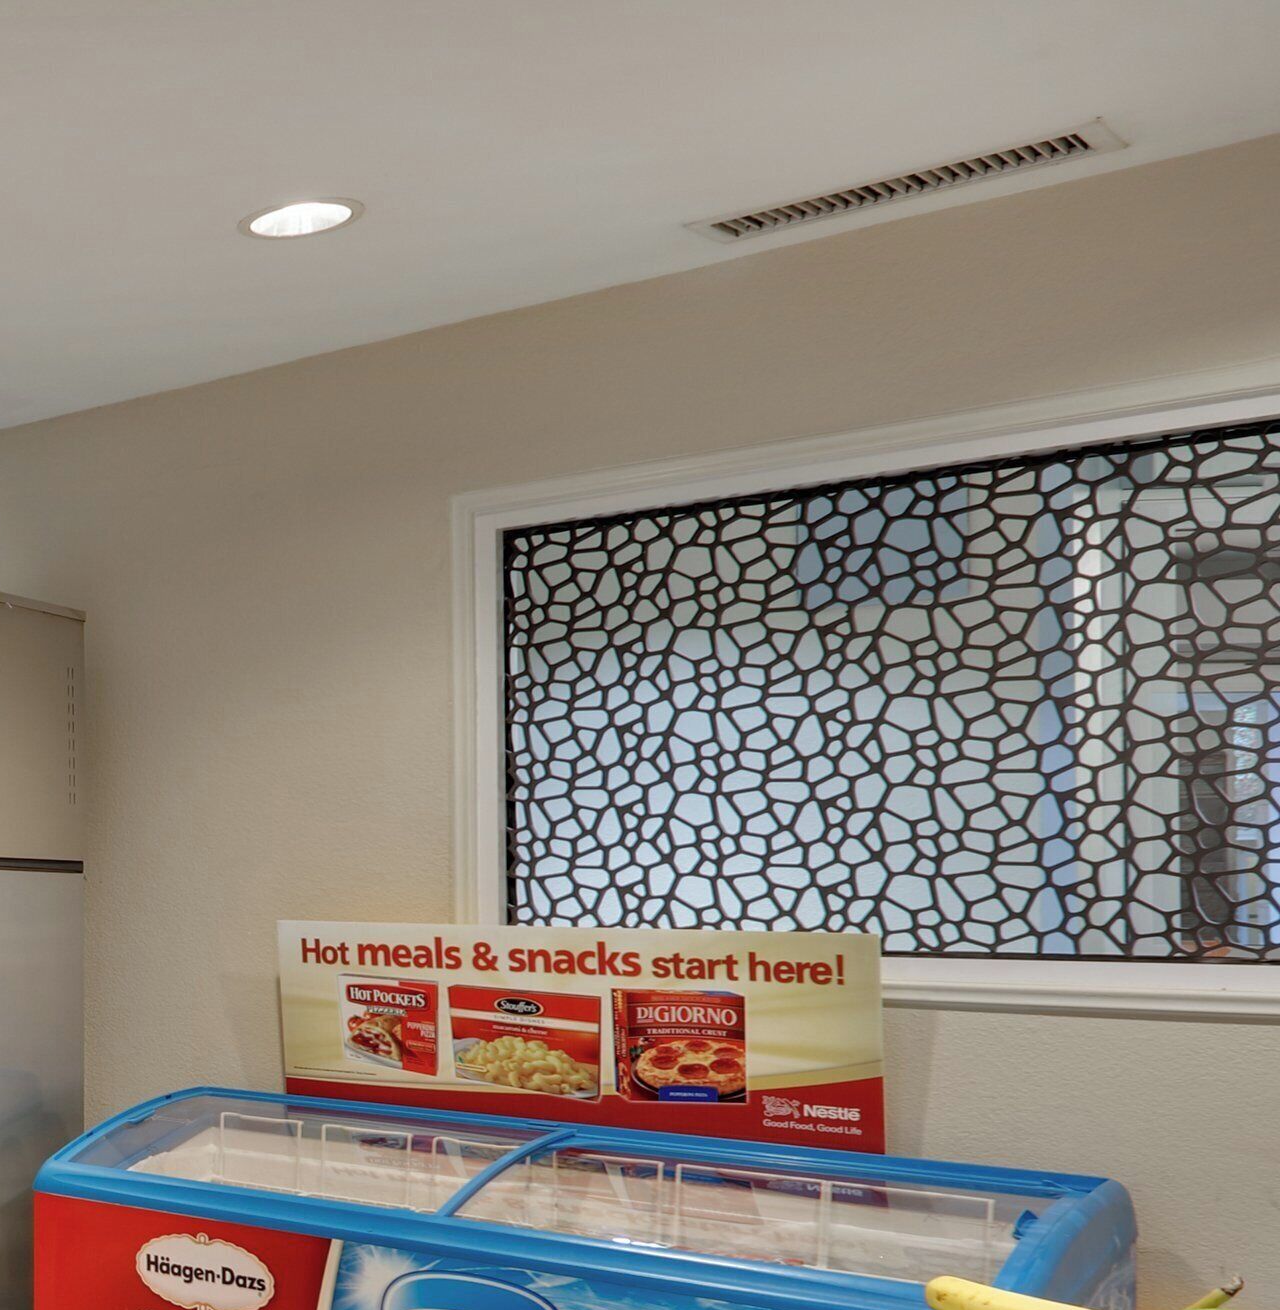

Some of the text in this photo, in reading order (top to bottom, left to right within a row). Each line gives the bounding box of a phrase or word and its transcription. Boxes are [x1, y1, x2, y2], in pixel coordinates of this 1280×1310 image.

[301, 936, 846, 986] Hot meals & snacks start here!
[349, 986, 427, 1009] HOT POCKETS
[498, 999, 540, 1016] Stouffer's
[636, 1004, 739, 1027] DIGIORNO
[646, 1027, 729, 1038] TRADITIONAL CRUST
[762, 1117, 863, 1137] Good Food, Good Life
